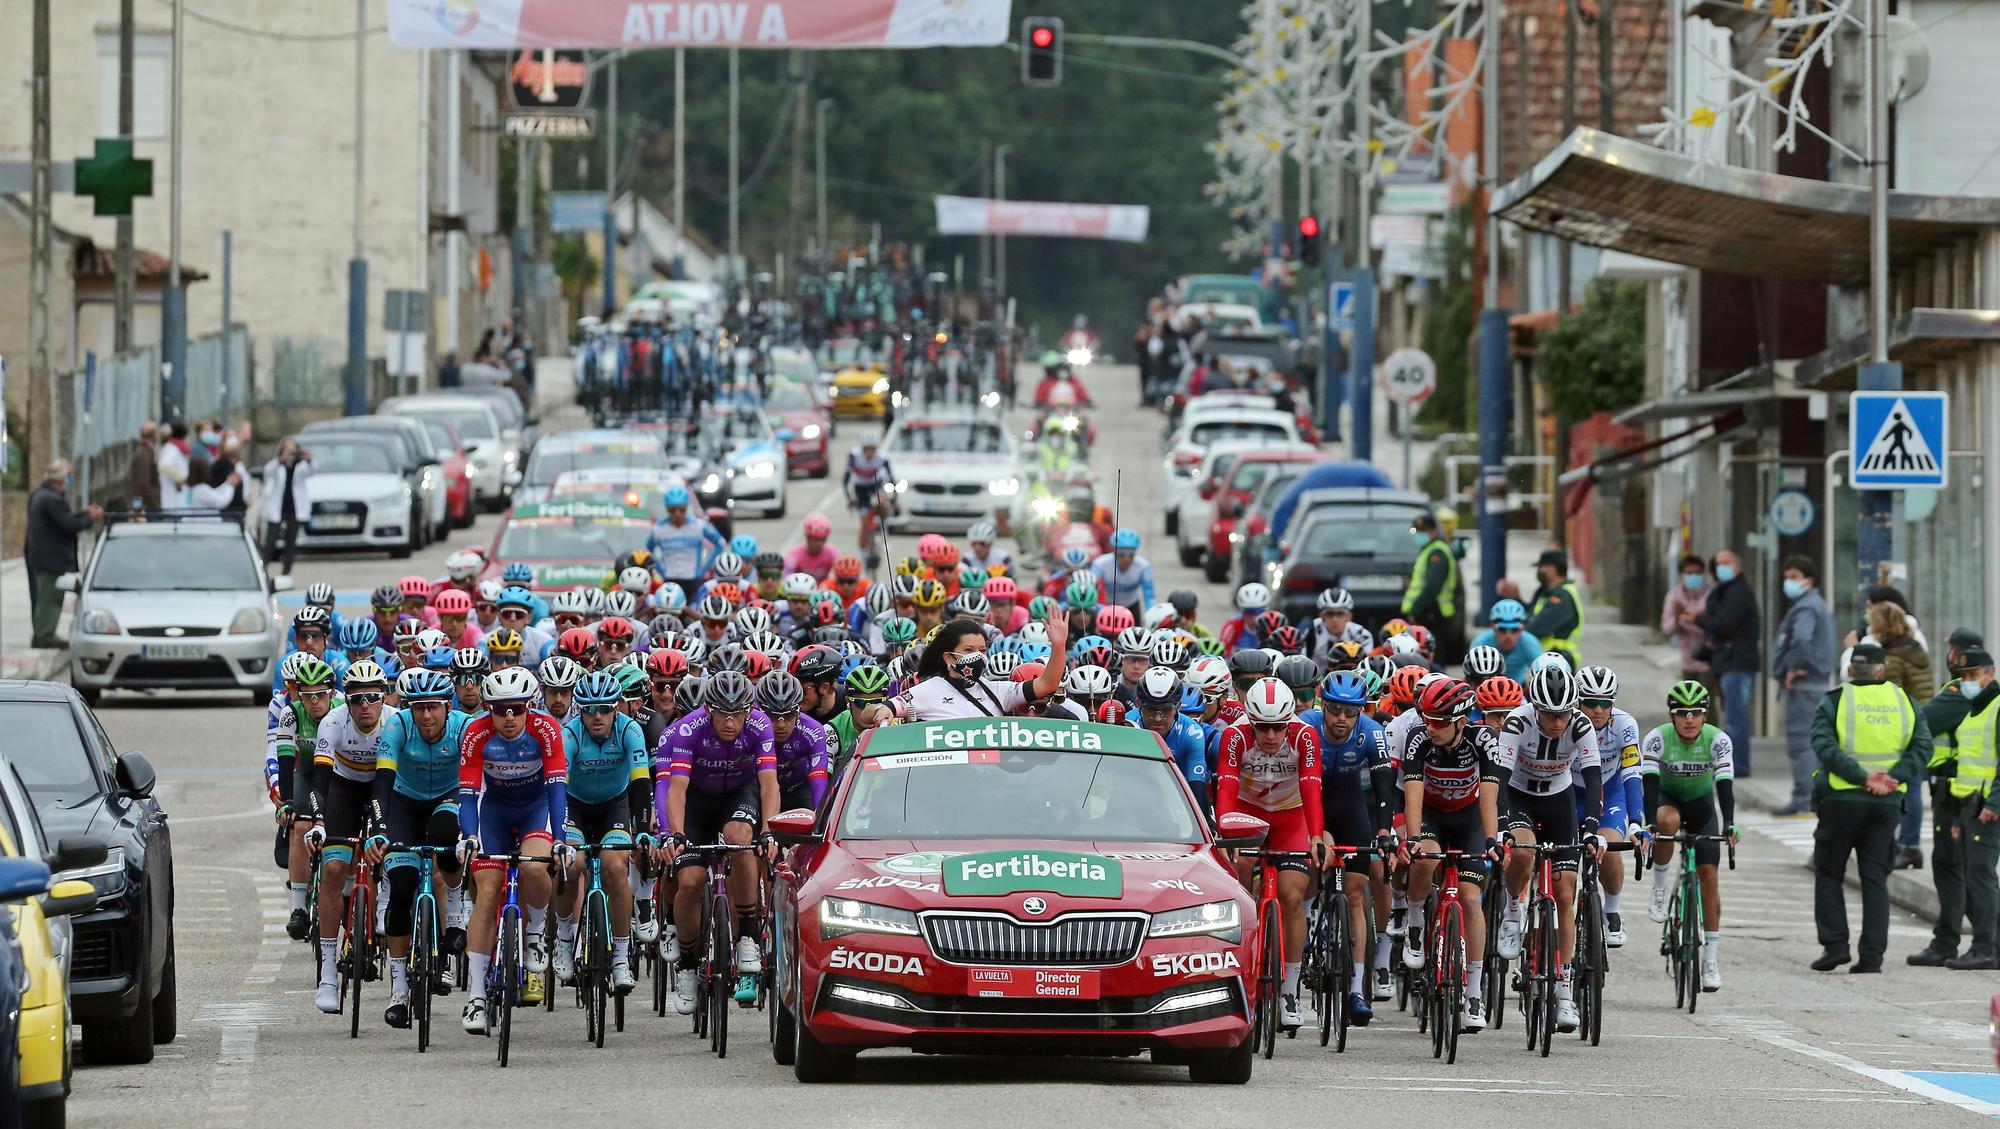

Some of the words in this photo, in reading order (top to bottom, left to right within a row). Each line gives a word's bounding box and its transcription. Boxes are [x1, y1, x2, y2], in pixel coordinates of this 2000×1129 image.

[505, 116, 592, 137] PIZZERIA
[1394, 366, 1425, 384] 40
[538, 502, 624, 517] Fertiberia
[1856, 704, 1898, 713] GUARDIA
[1865, 714, 1890, 724] CIVIL
[542, 721, 558, 741] TOTAL
[925, 721, 1102, 750] Fertiberia
[461, 731, 475, 754] TOTAL
[1228, 733, 1241, 767] Cofidis
[1302, 732, 1316, 768] Cofidis
[1373, 730, 1388, 759] BMC
[1406, 731, 1429, 760] SOUDA
[896, 753, 953, 764] DIRECCIÓN
[1241, 762, 1297, 774] Cofidis
[961, 854, 1106, 881] Fertiberia
[1290, 861, 1308, 870] ROSA
[834, 874, 940, 893] ŠKODA
[1150, 877, 1205, 895] rtve
[829, 945, 925, 976] ŠKODA
[1153, 951, 1241, 977] ŠKODA
[975, 972, 983, 980] LA
[983, 972, 1009, 981] VUELTA
[1036, 971, 1081, 983] Director
[1036, 985, 1080, 996] General
